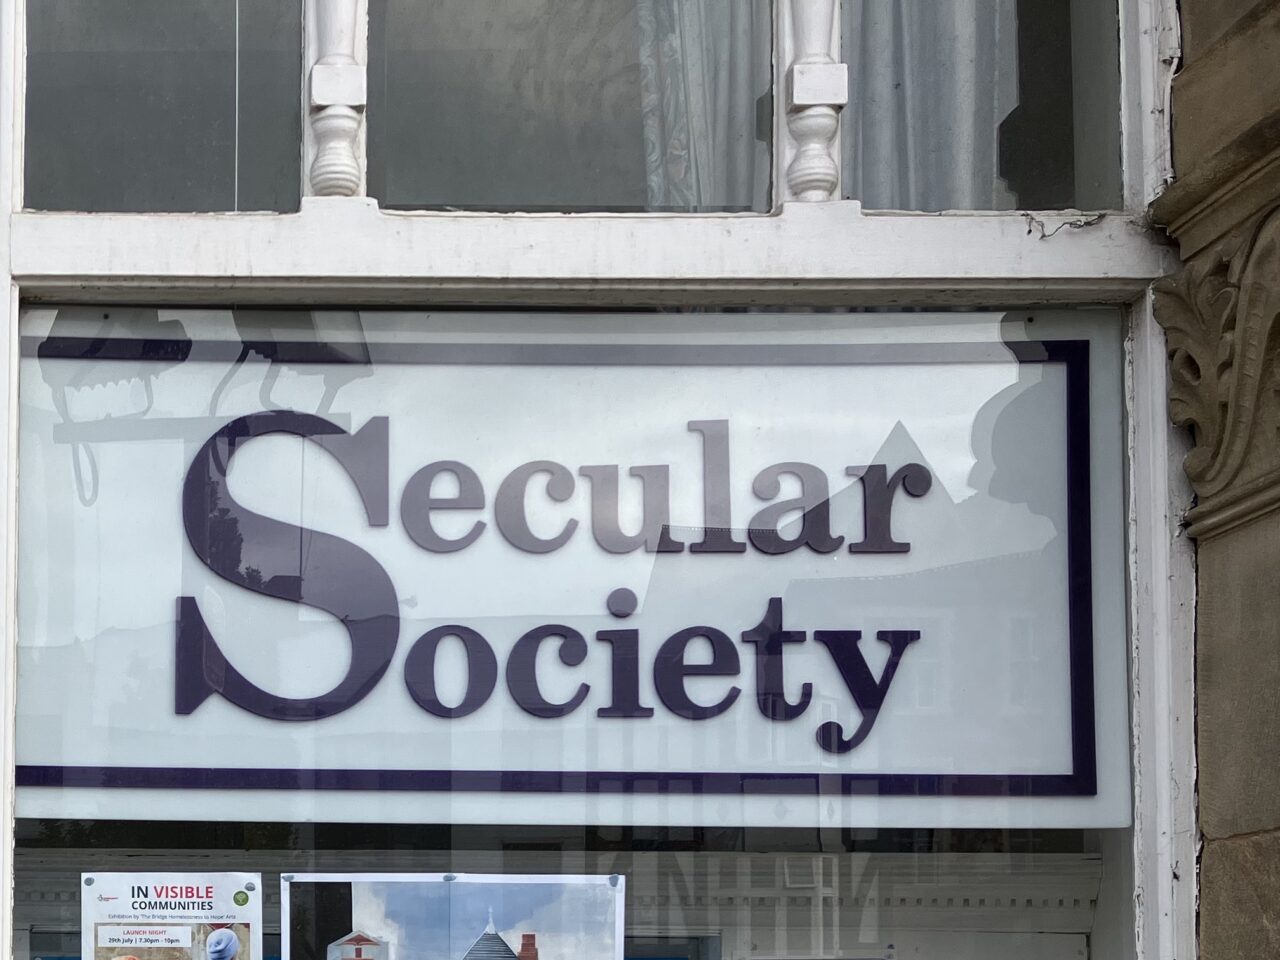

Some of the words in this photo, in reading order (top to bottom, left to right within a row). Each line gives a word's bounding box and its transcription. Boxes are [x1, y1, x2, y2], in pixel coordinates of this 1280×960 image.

[175, 409, 932, 722] Secular
[131, 886, 148, 899] IN
[154, 886, 214, 899] VISIBLE
[131, 901, 213, 910] COMMUNITIES
